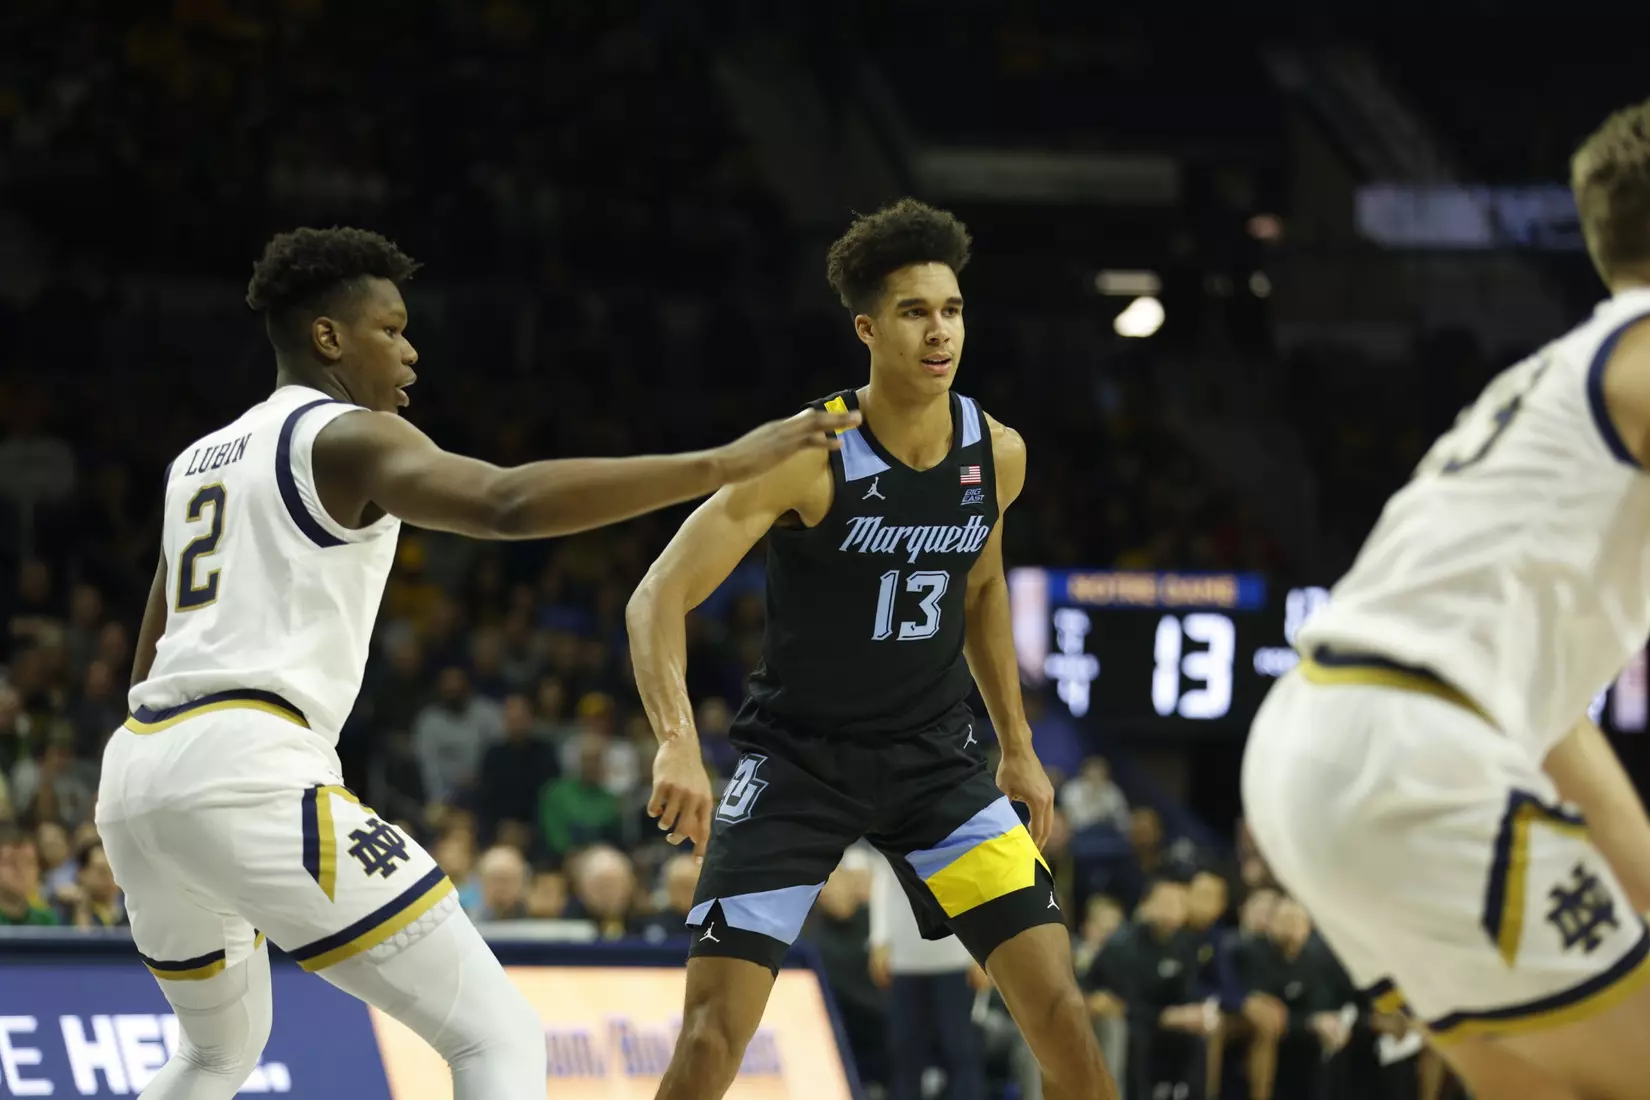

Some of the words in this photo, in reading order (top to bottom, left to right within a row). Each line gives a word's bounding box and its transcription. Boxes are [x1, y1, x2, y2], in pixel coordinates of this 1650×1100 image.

[184, 432, 253, 477] LUBIN
[962, 494, 985, 503] EAST
[965, 488, 982, 496] BIG
[175, 481, 228, 613] 2
[839, 515, 990, 564] Marquette
[871, 570, 950, 641] 13
[1152, 613, 1236, 719] 13
[0, 1015, 54, 1096] E
